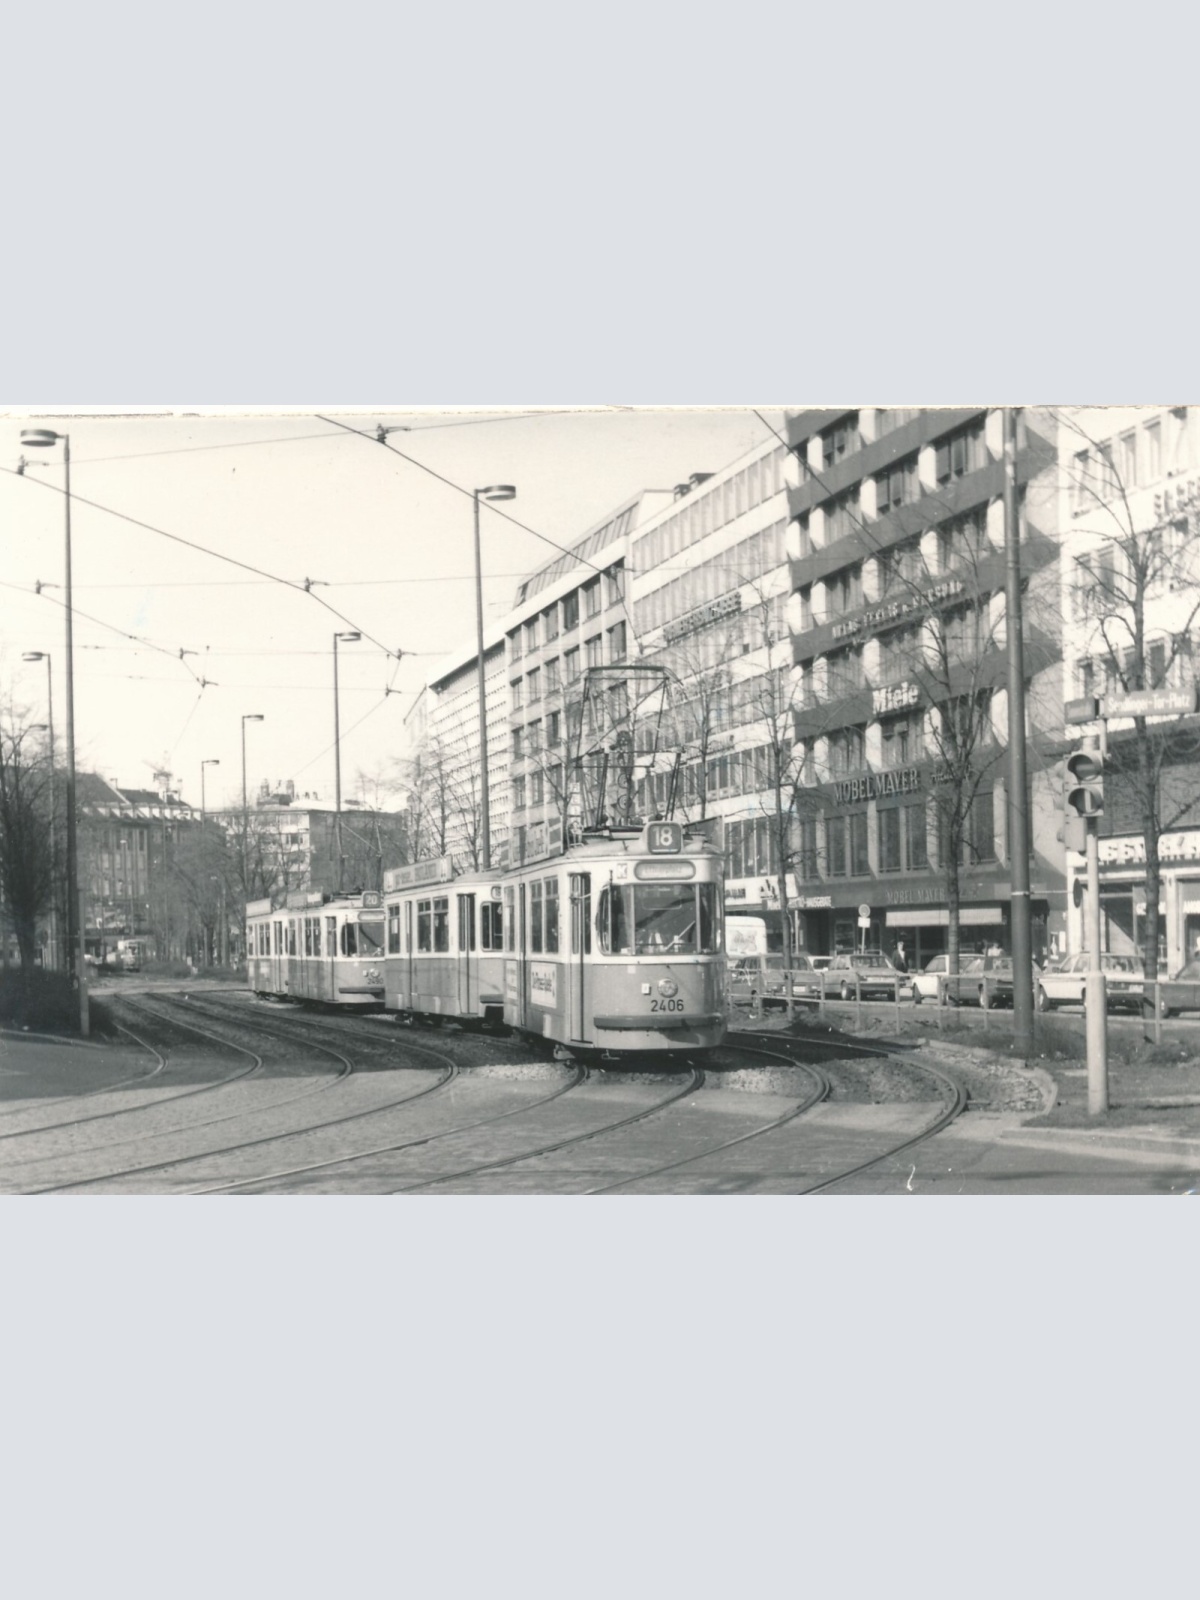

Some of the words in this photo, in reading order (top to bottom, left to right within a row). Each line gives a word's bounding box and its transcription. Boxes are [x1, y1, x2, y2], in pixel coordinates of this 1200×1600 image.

[872, 681, 919, 714] Miele
[875, 768, 919, 796] MAYER
[652, 826, 673, 847] 18
[365, 894, 378, 905] 20
[650, 998, 685, 1012] 2406
